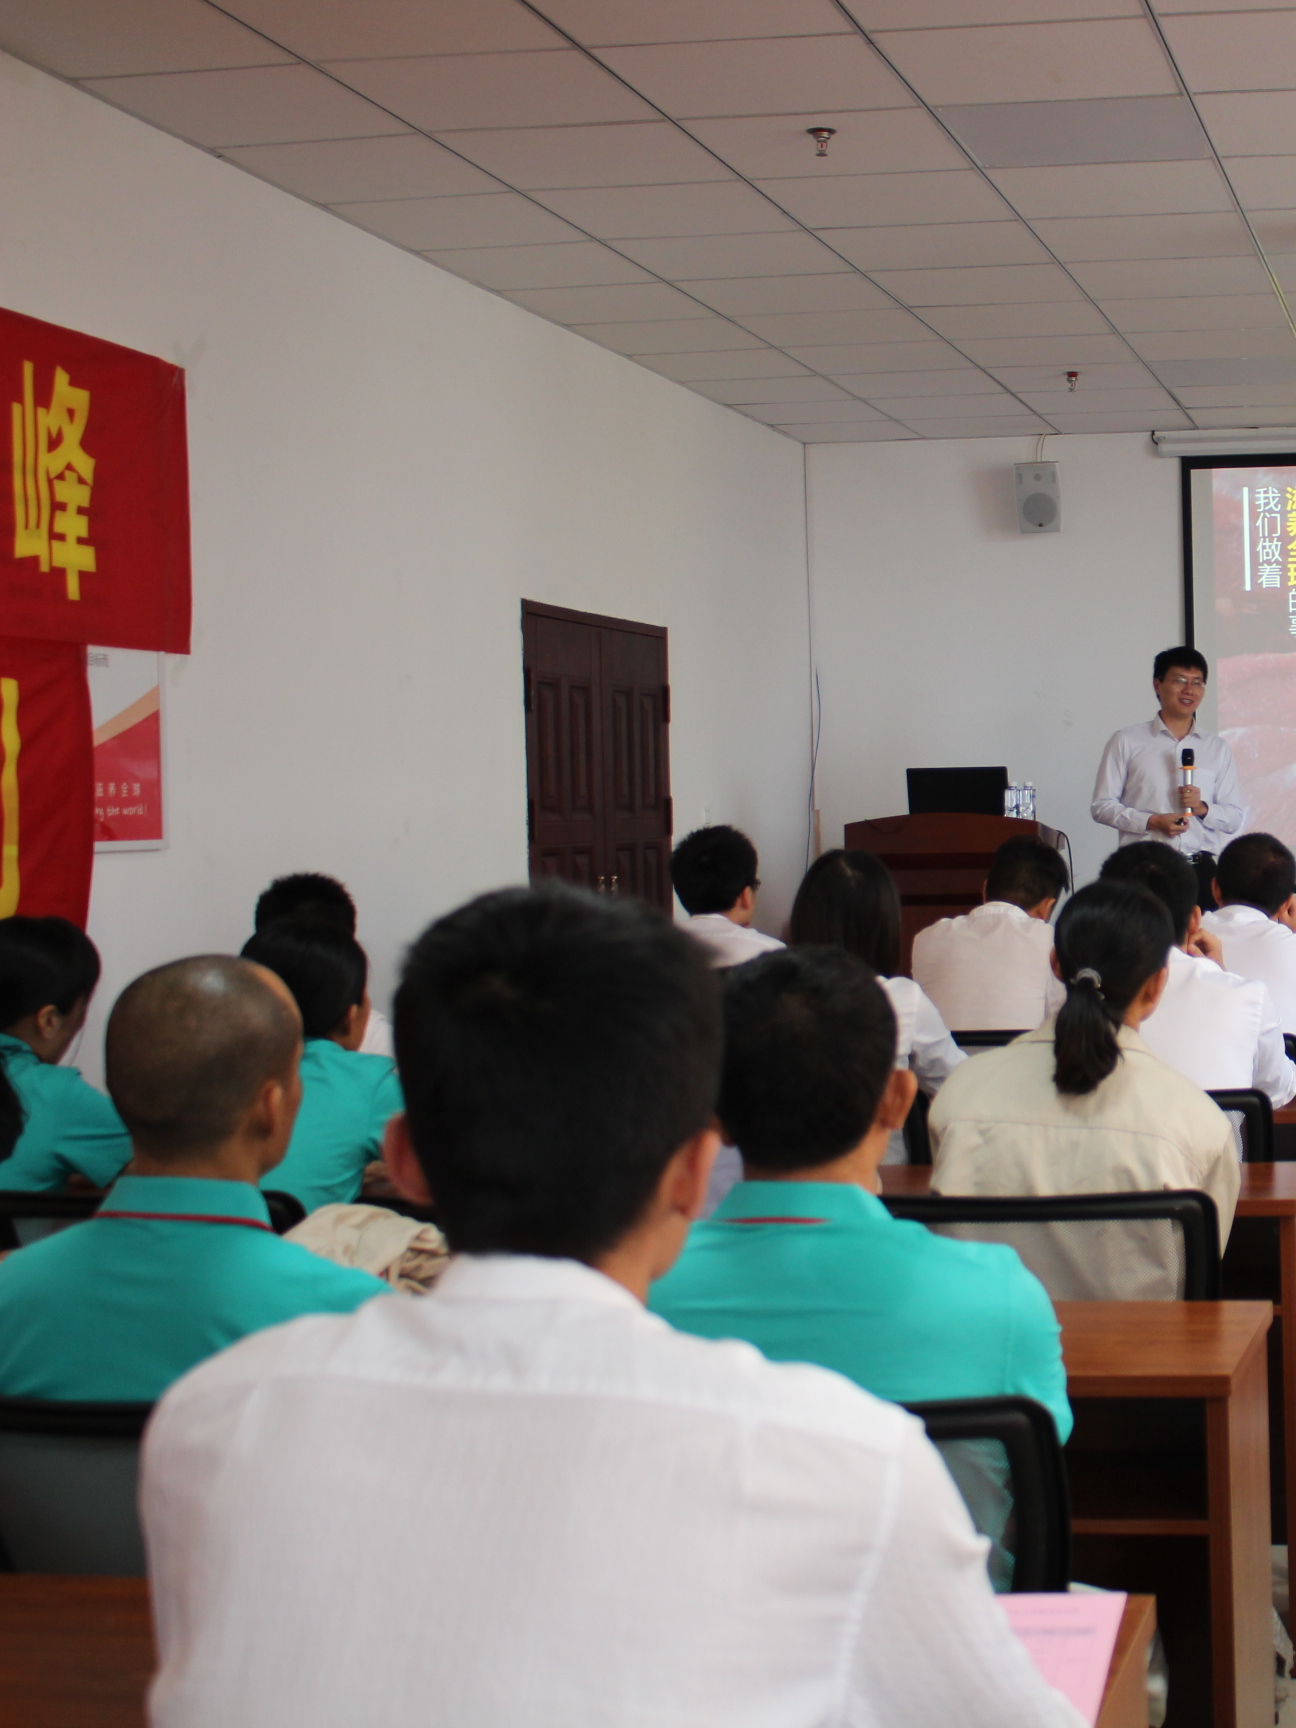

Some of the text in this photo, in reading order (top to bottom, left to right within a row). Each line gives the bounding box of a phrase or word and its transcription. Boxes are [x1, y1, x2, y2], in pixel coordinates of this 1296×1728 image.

[12, 359, 97, 601] 峰
[1254, 486, 1282, 589] 我们做着
[106, 805, 121, 816] the
